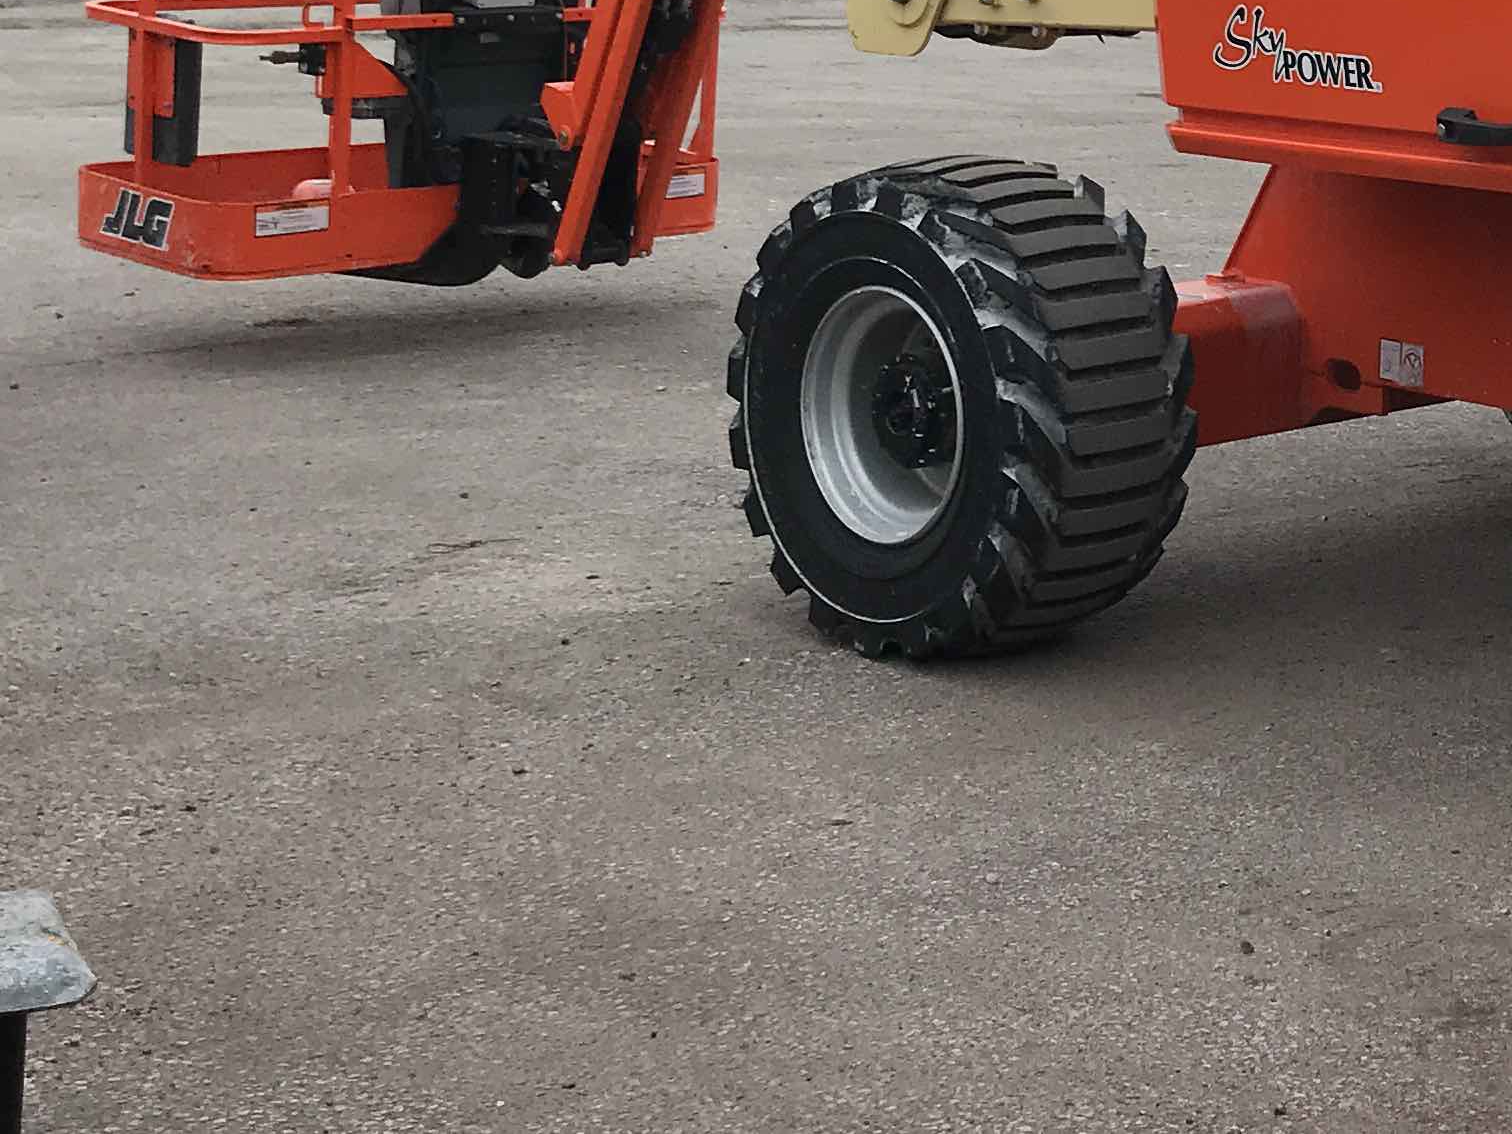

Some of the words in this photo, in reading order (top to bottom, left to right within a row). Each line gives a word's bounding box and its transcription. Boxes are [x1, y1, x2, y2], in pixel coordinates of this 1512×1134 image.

[1214, 7, 1284, 81] Sky
[1281, 50, 1374, 89] POWER
[102, 189, 172, 247] JLG
